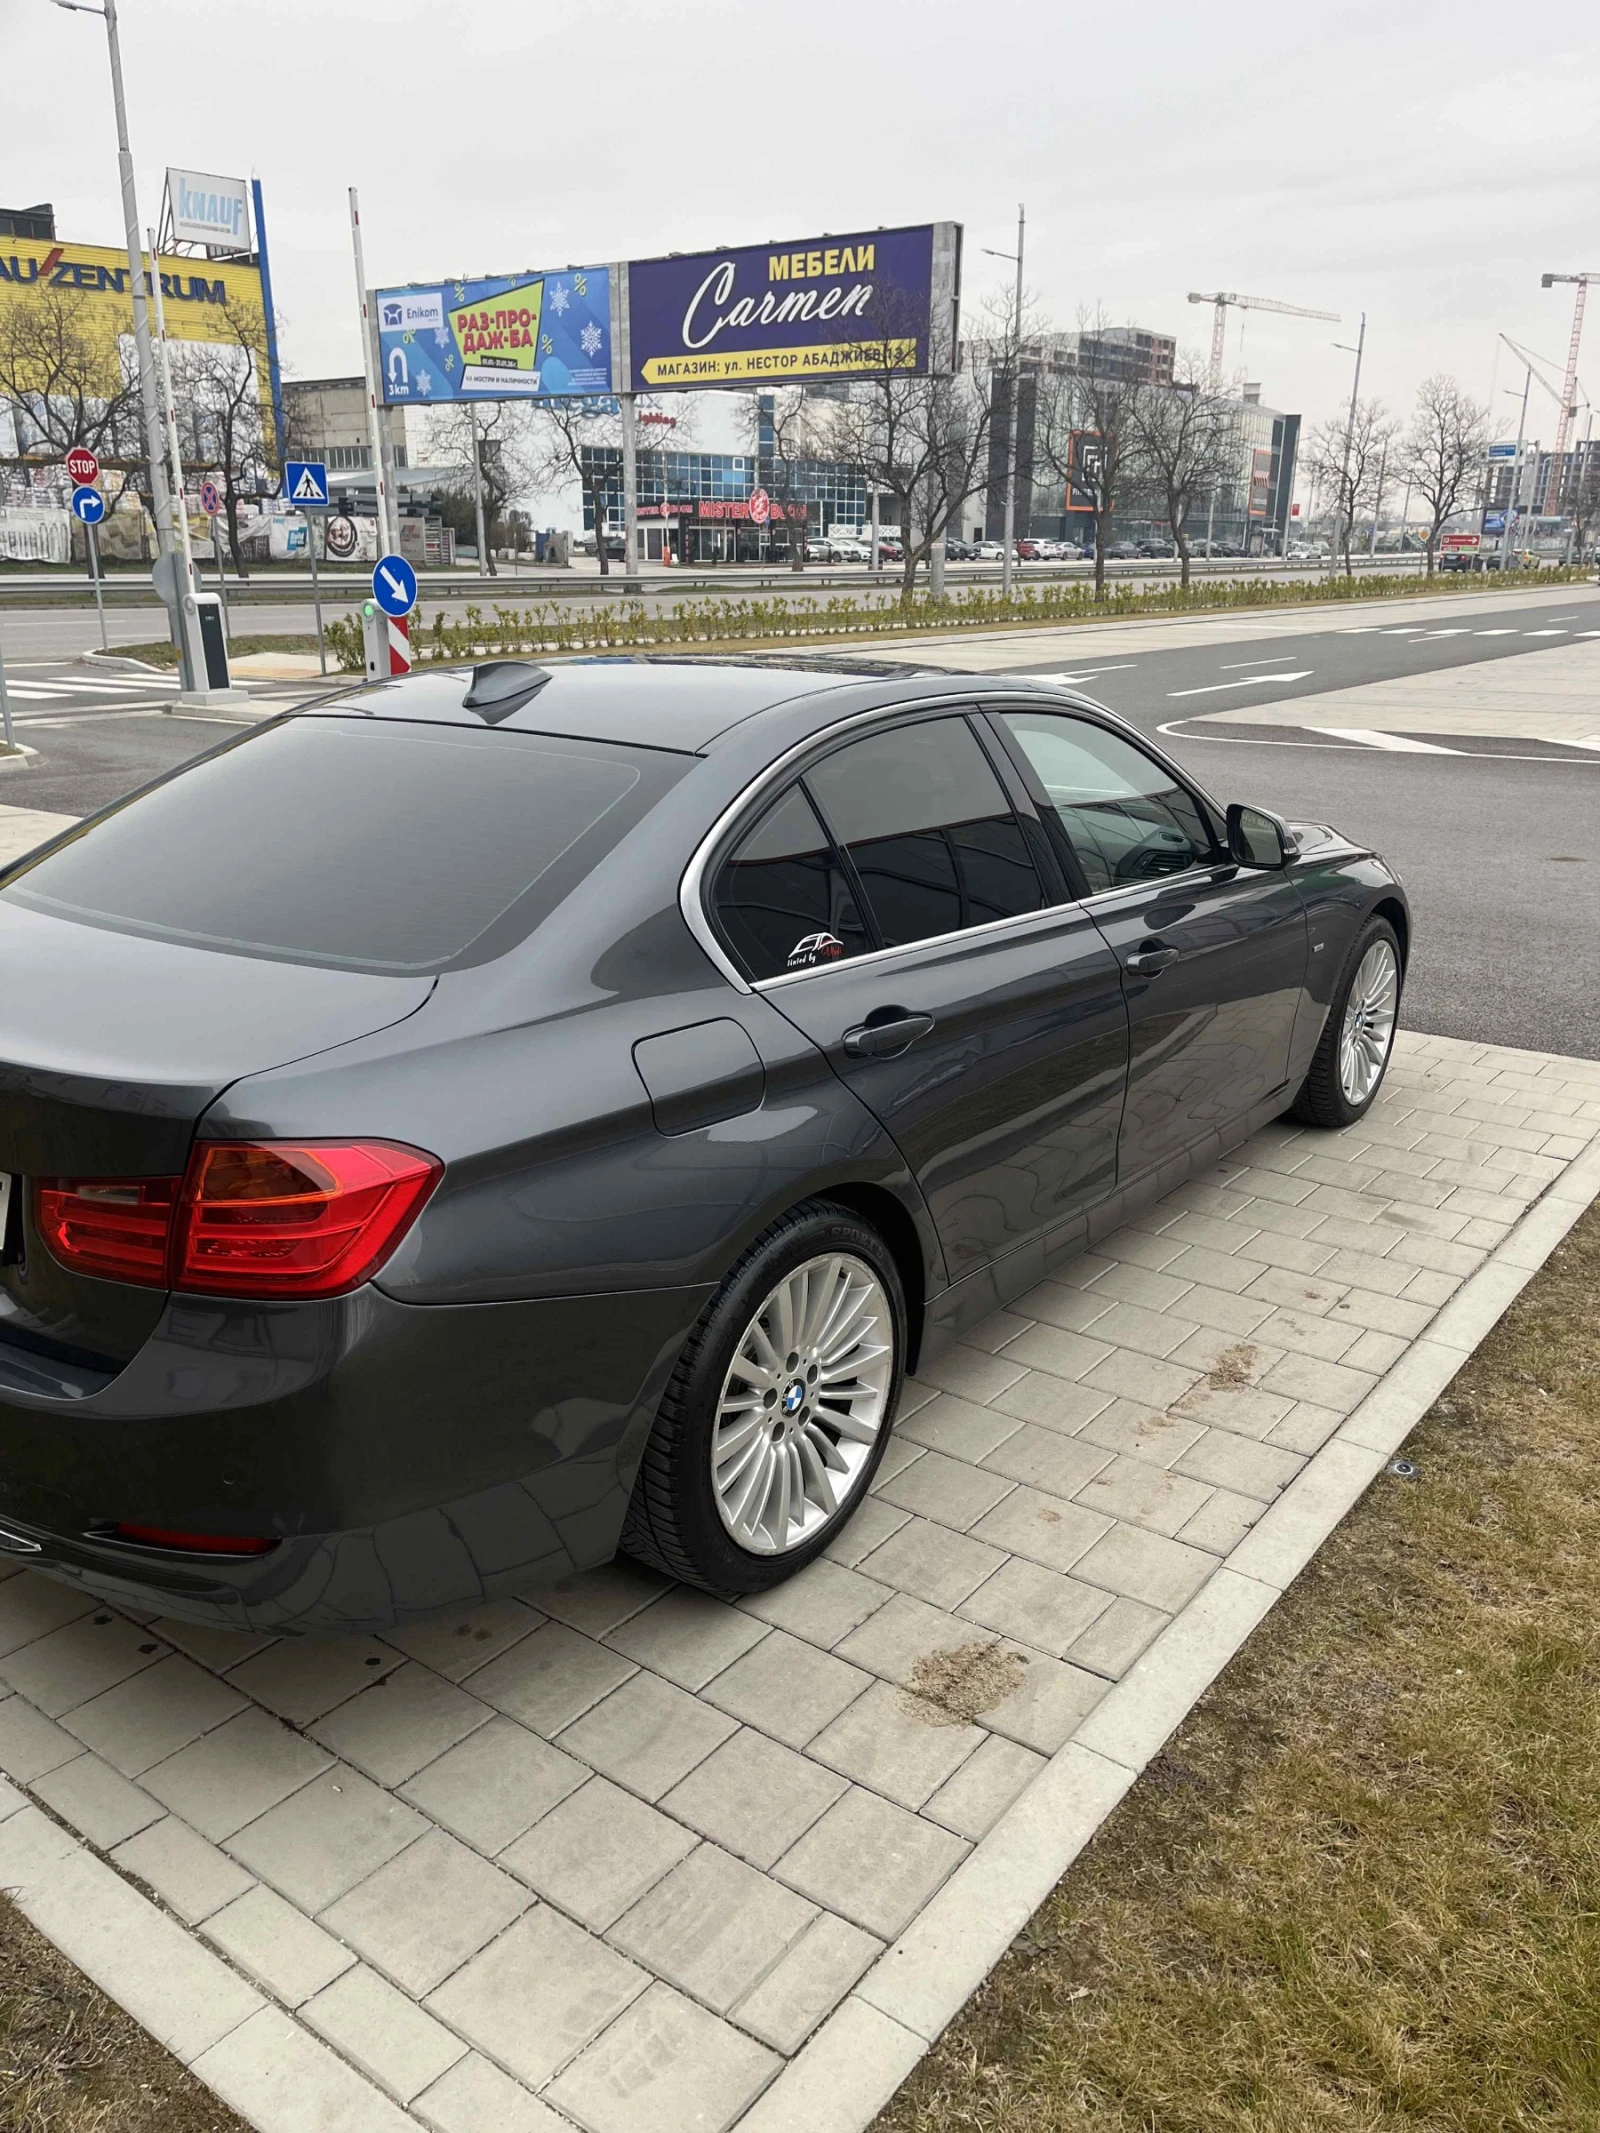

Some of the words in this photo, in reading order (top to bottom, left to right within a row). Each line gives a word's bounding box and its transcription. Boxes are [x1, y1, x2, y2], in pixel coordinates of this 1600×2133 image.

[769, 244, 875, 281] МЕБЕЛИ
[407, 306, 439, 319] Enikom
[682, 262, 873, 348] Carmen
[457, 308, 537, 333] РАЗ-ПРО-
[463, 329, 534, 355] ДАЖ-БА
[657, 361, 720, 376] МАГАЗИН:
[724, 362, 742, 374] ул.
[747, 355, 798, 370] НЕСТОР
[802, 348, 881, 367] АБАДЖИЕВ
[70, 459, 96, 474] STOP
[636, 506, 660, 517] ISTER
[699, 501, 750, 519] MISTER
[808, 952, 816, 964] by
